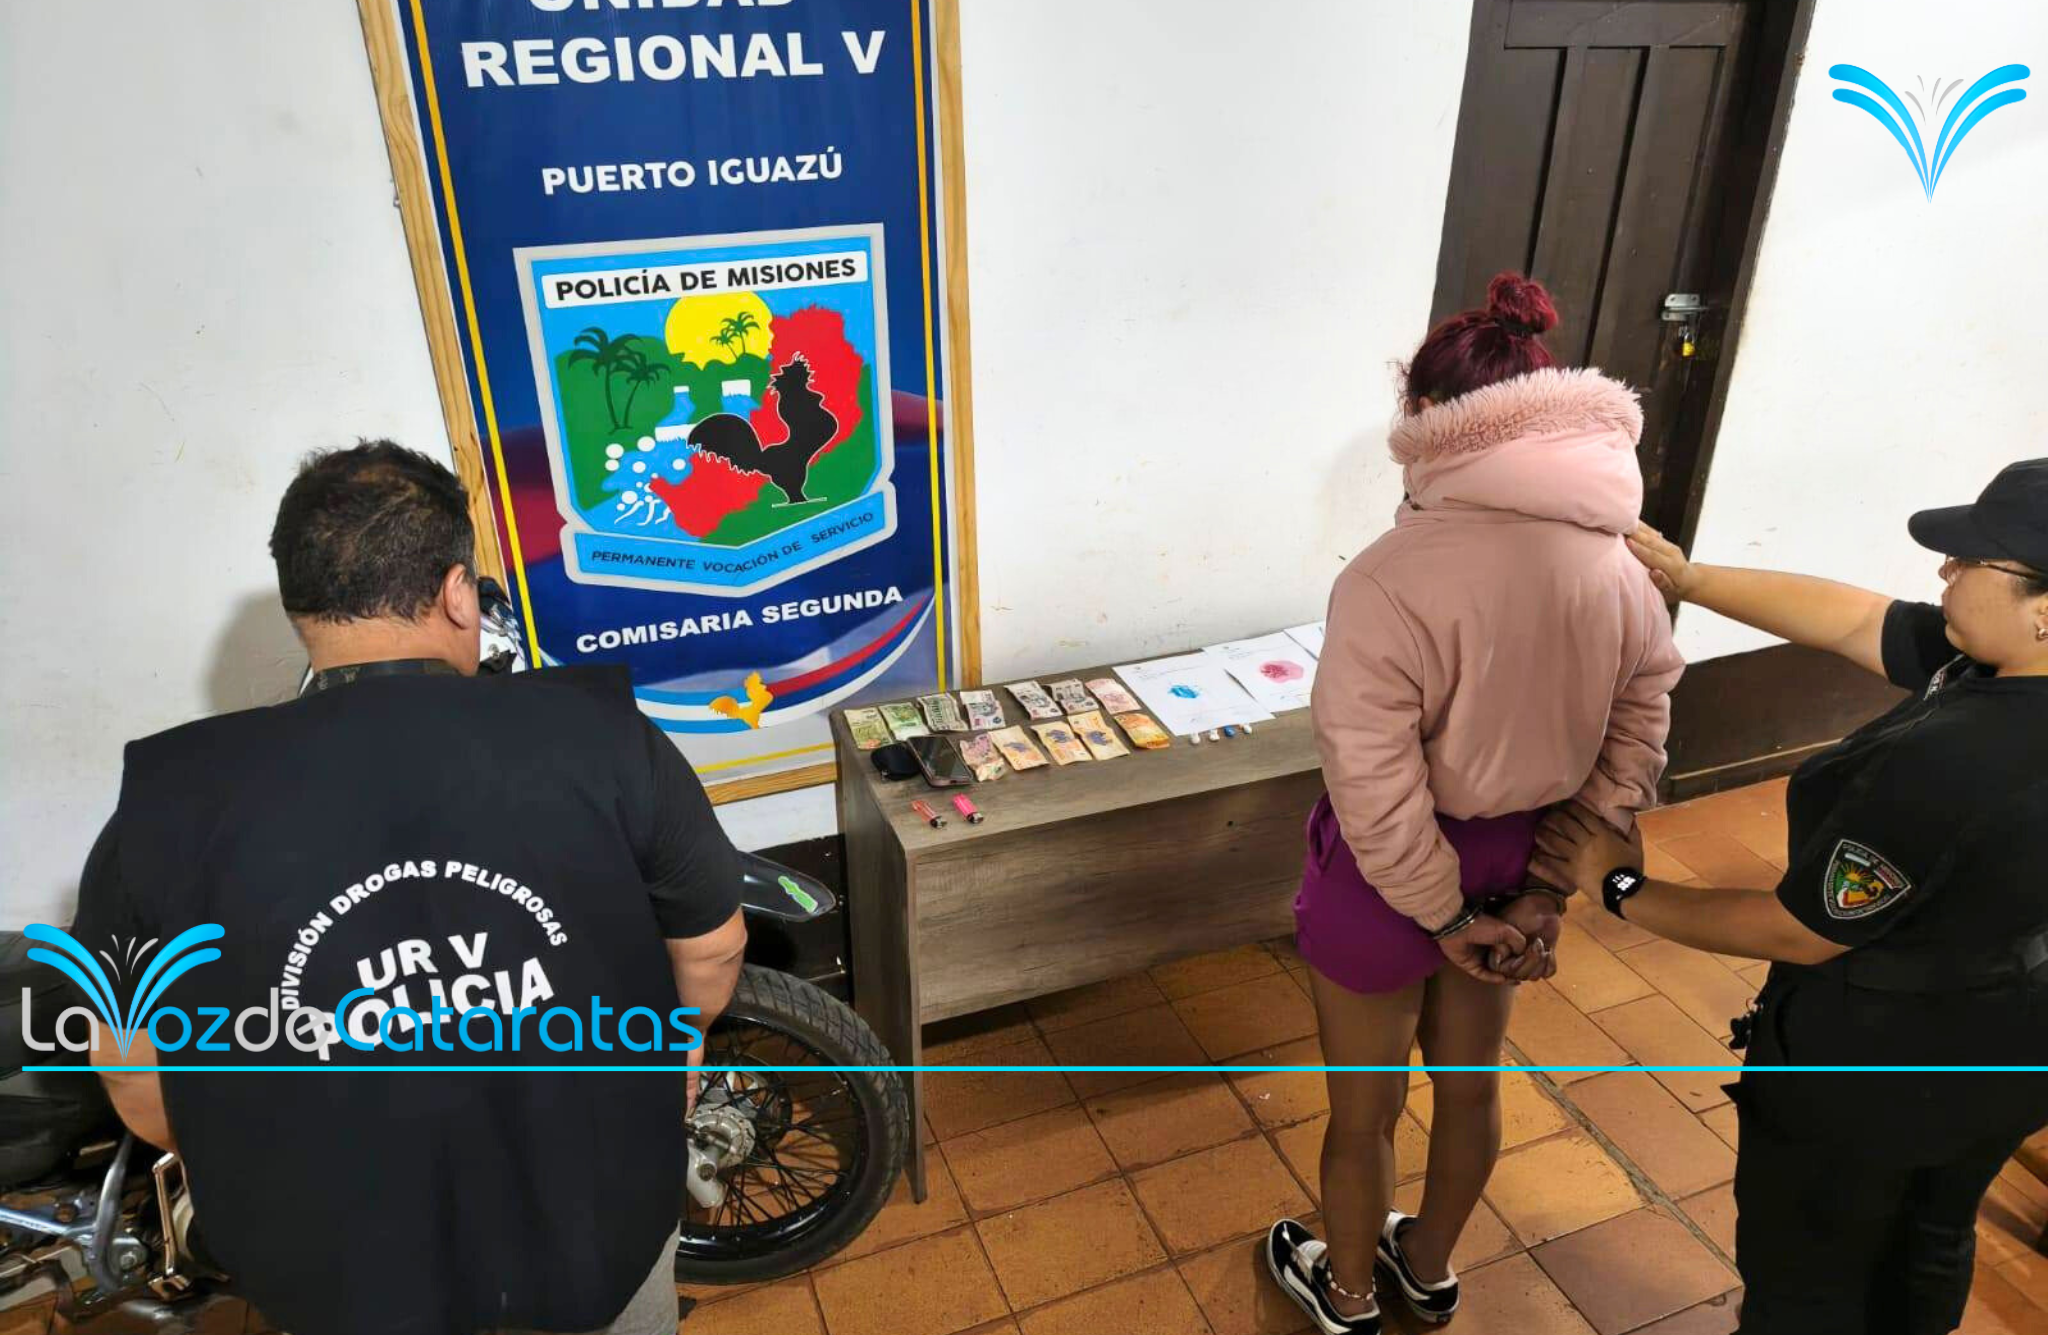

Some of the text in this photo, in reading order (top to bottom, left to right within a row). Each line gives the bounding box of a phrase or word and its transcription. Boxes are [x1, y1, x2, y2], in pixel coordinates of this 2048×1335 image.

[461, 31, 885, 87] REGIONAL V
[542, 147, 842, 194] PUERTO IGUAZÚ
[556, 258, 856, 301] POLICÍA DE MISIONES
[592, 512, 873, 573] PERMANENTE VOCACIÓN DE SERVICIO
[577, 586, 903, 652] COMISARIA SEGUNDA
[281, 860, 568, 1010] DIVISIÓN DROGAS PELIGROSAS
[357, 932, 488, 991] UR V
[308, 957, 554, 1061] POLICIA
